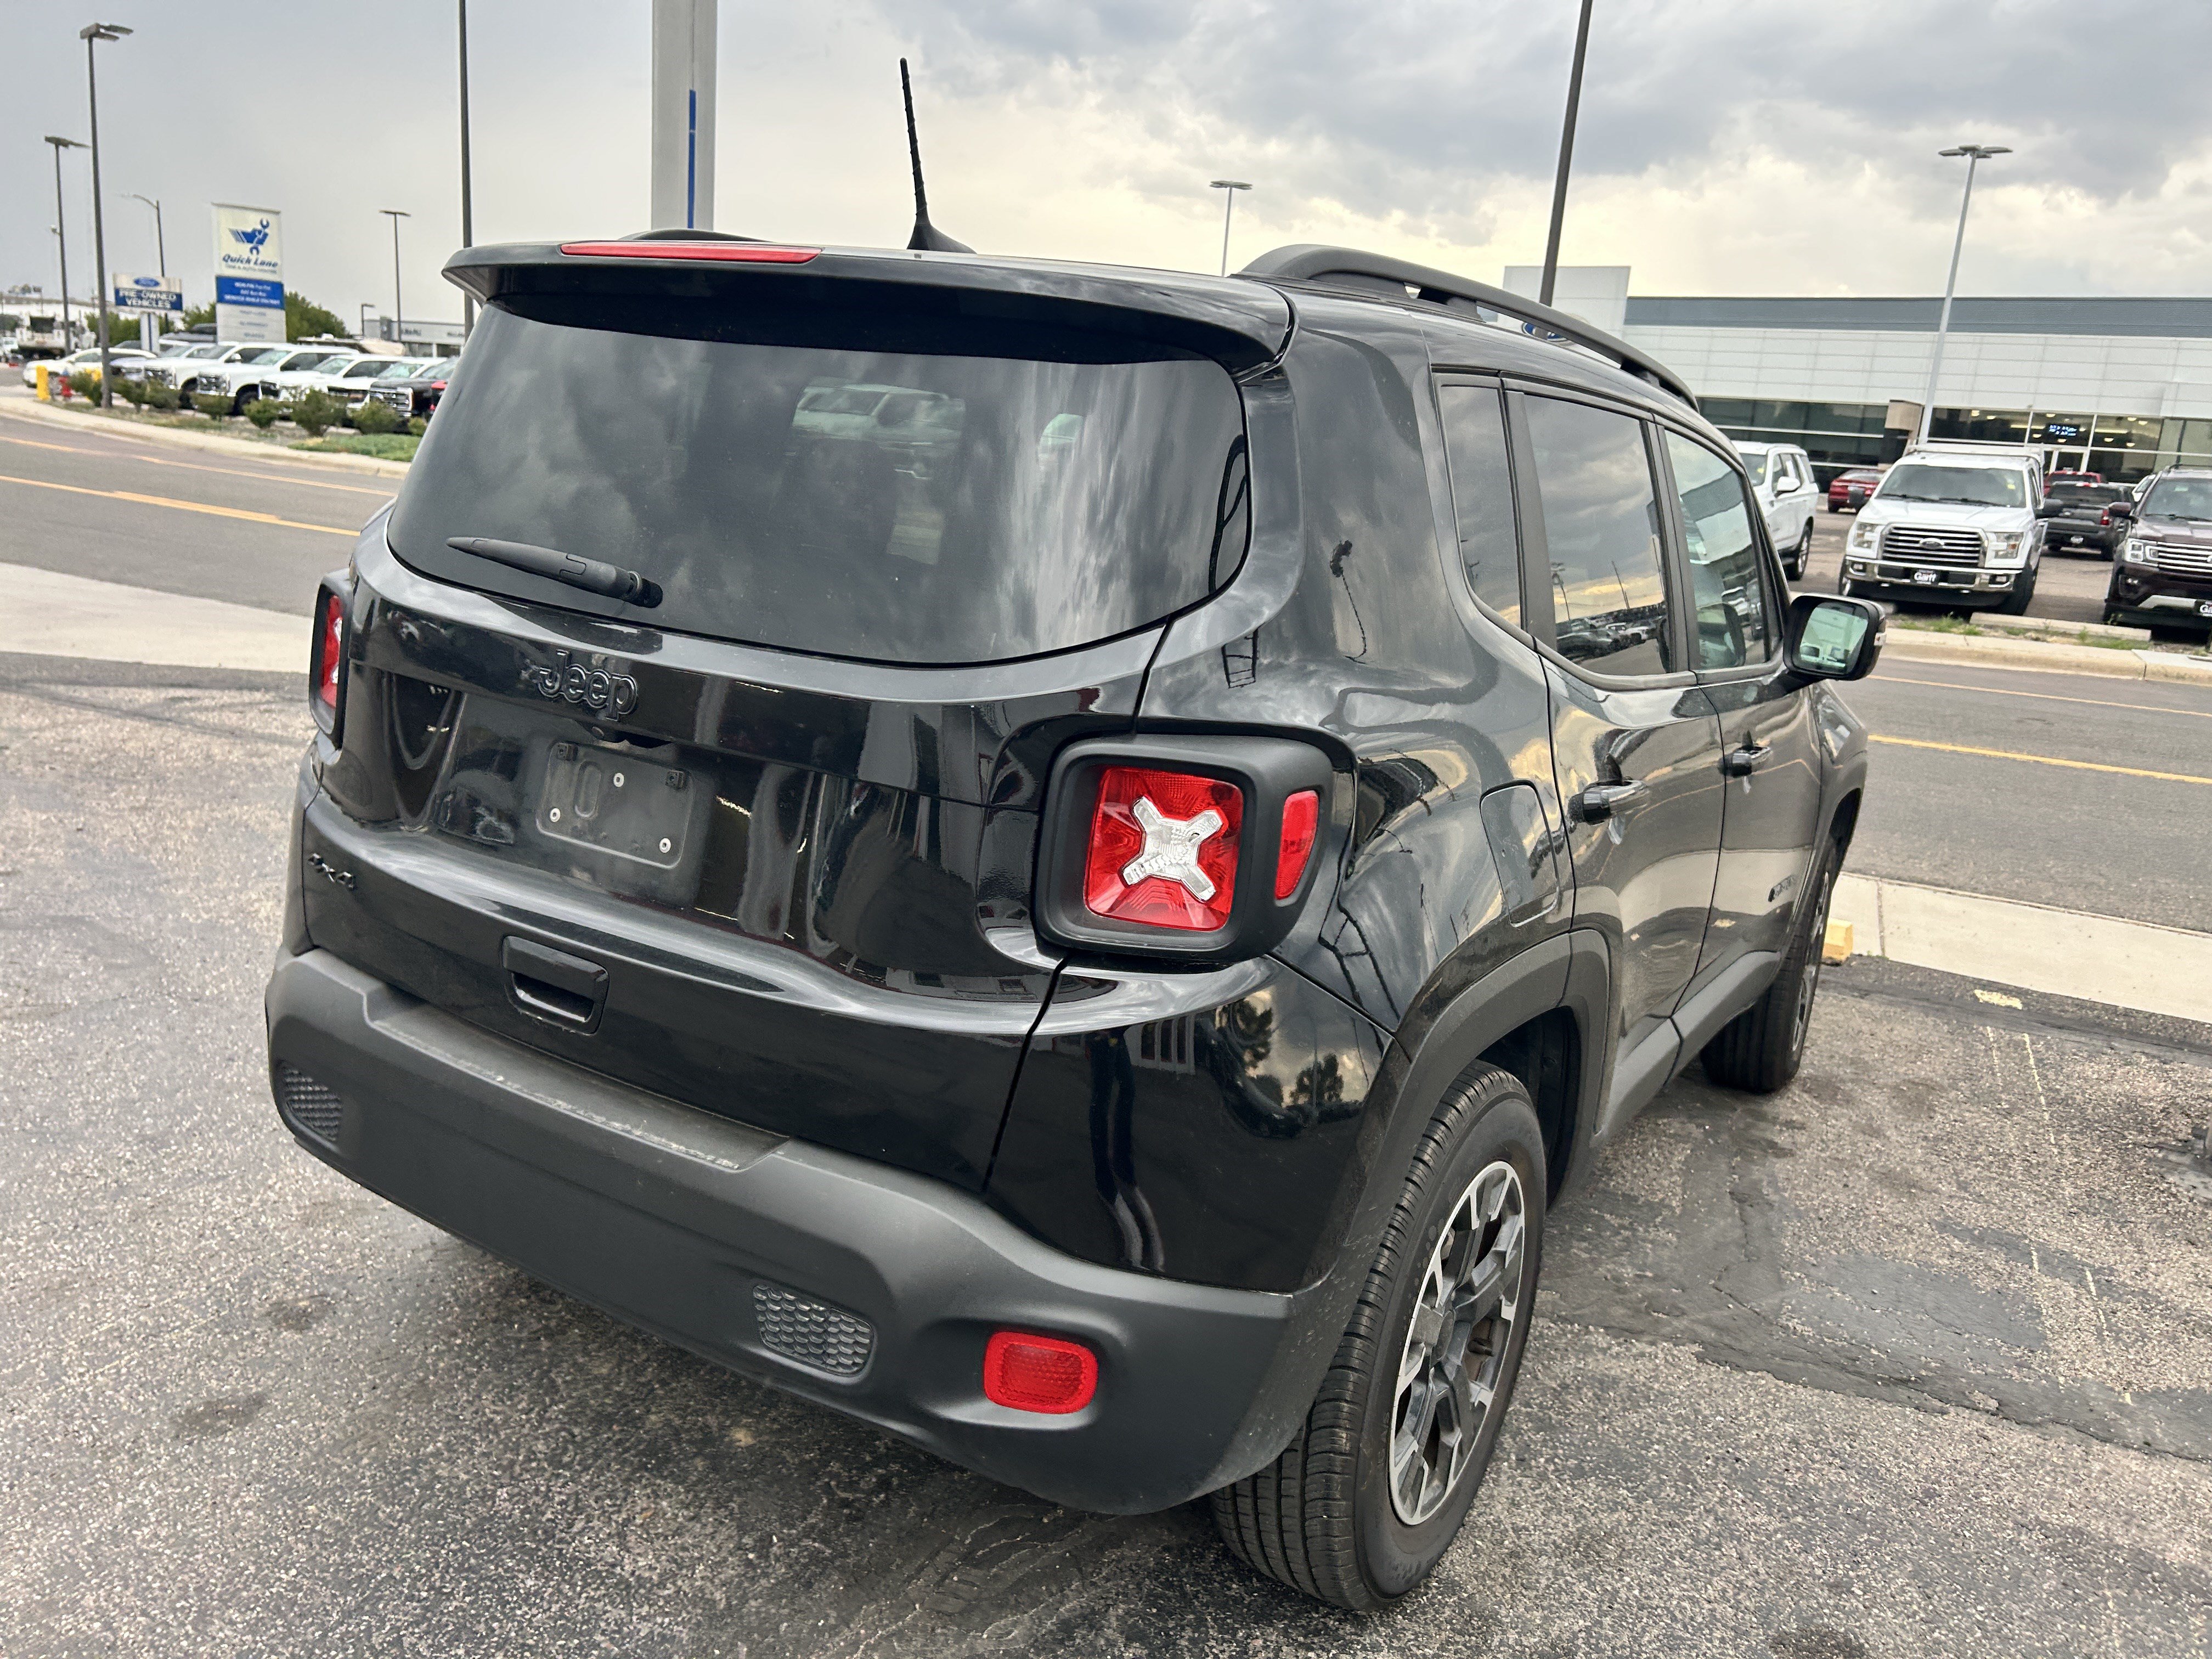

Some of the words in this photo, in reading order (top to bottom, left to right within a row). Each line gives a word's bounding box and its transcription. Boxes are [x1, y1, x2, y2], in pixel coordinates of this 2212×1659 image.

[222, 253, 251, 264] Quick
[253, 256, 278, 267] Lane
[126, 297, 171, 309] VEHICLES
[538, 649, 639, 721] Jeep
